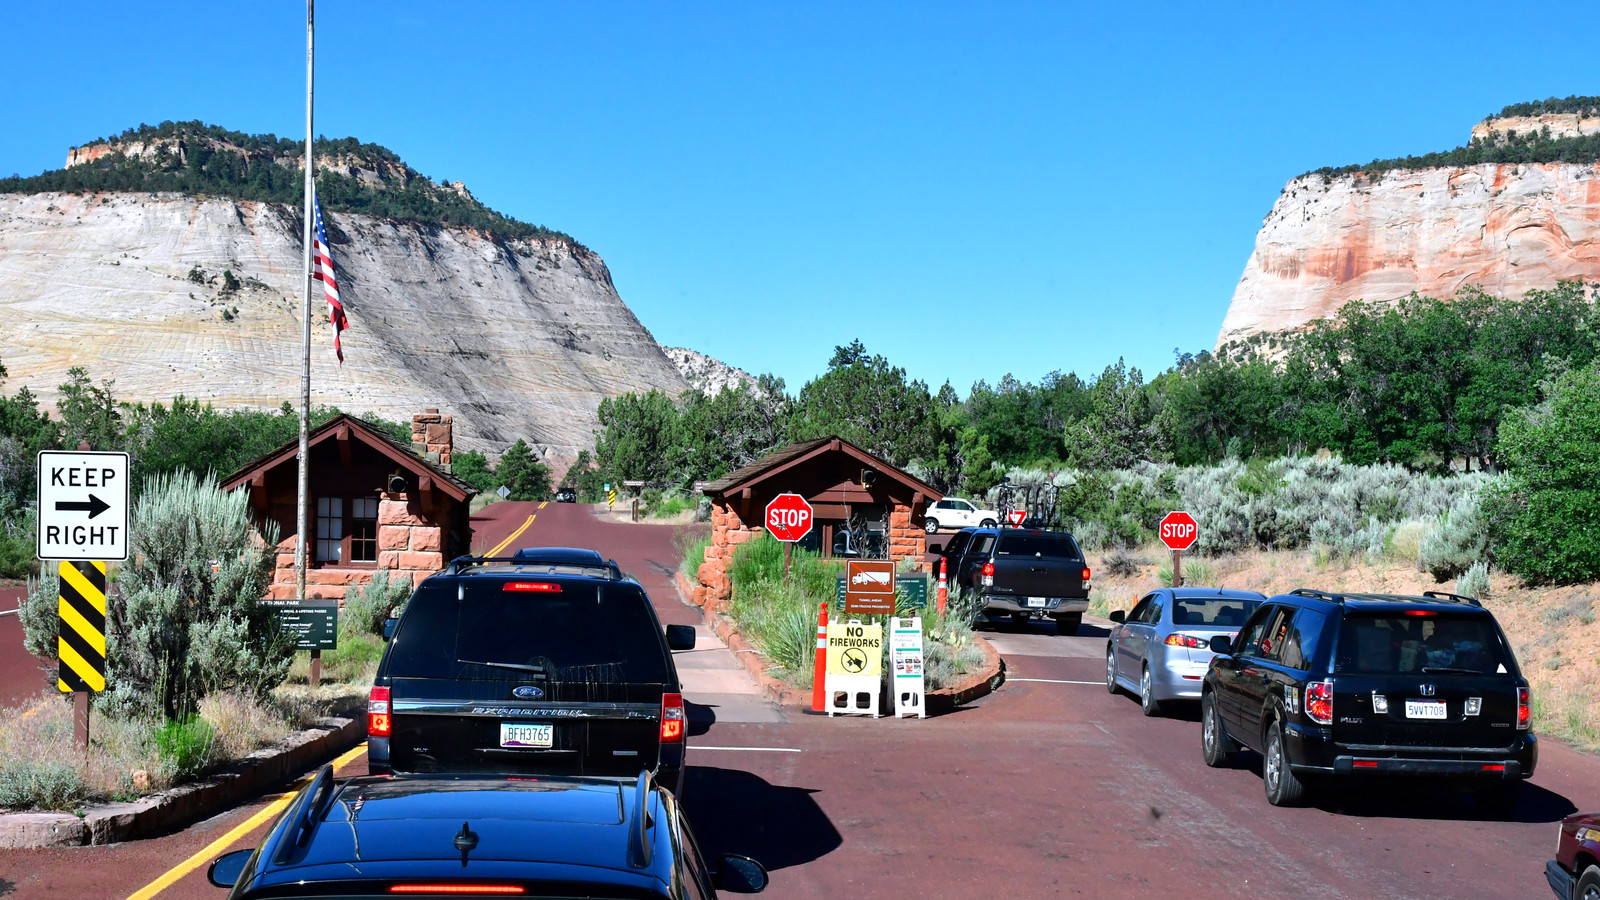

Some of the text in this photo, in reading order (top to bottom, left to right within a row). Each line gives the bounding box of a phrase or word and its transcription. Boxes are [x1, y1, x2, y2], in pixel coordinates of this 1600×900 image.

[51, 467, 116, 487] KEEP
[769, 508, 809, 527] STOP
[46, 525, 119, 546] RIGHT
[1162, 522, 1195, 538] STOP
[846, 627, 864, 638] NO
[829, 637, 880, 648] FIREWORKS
[471, 707, 583, 719] EXPEDITION
[1408, 705, 1445, 716] 5VVT708
[508, 727, 550, 741] BFH3765
